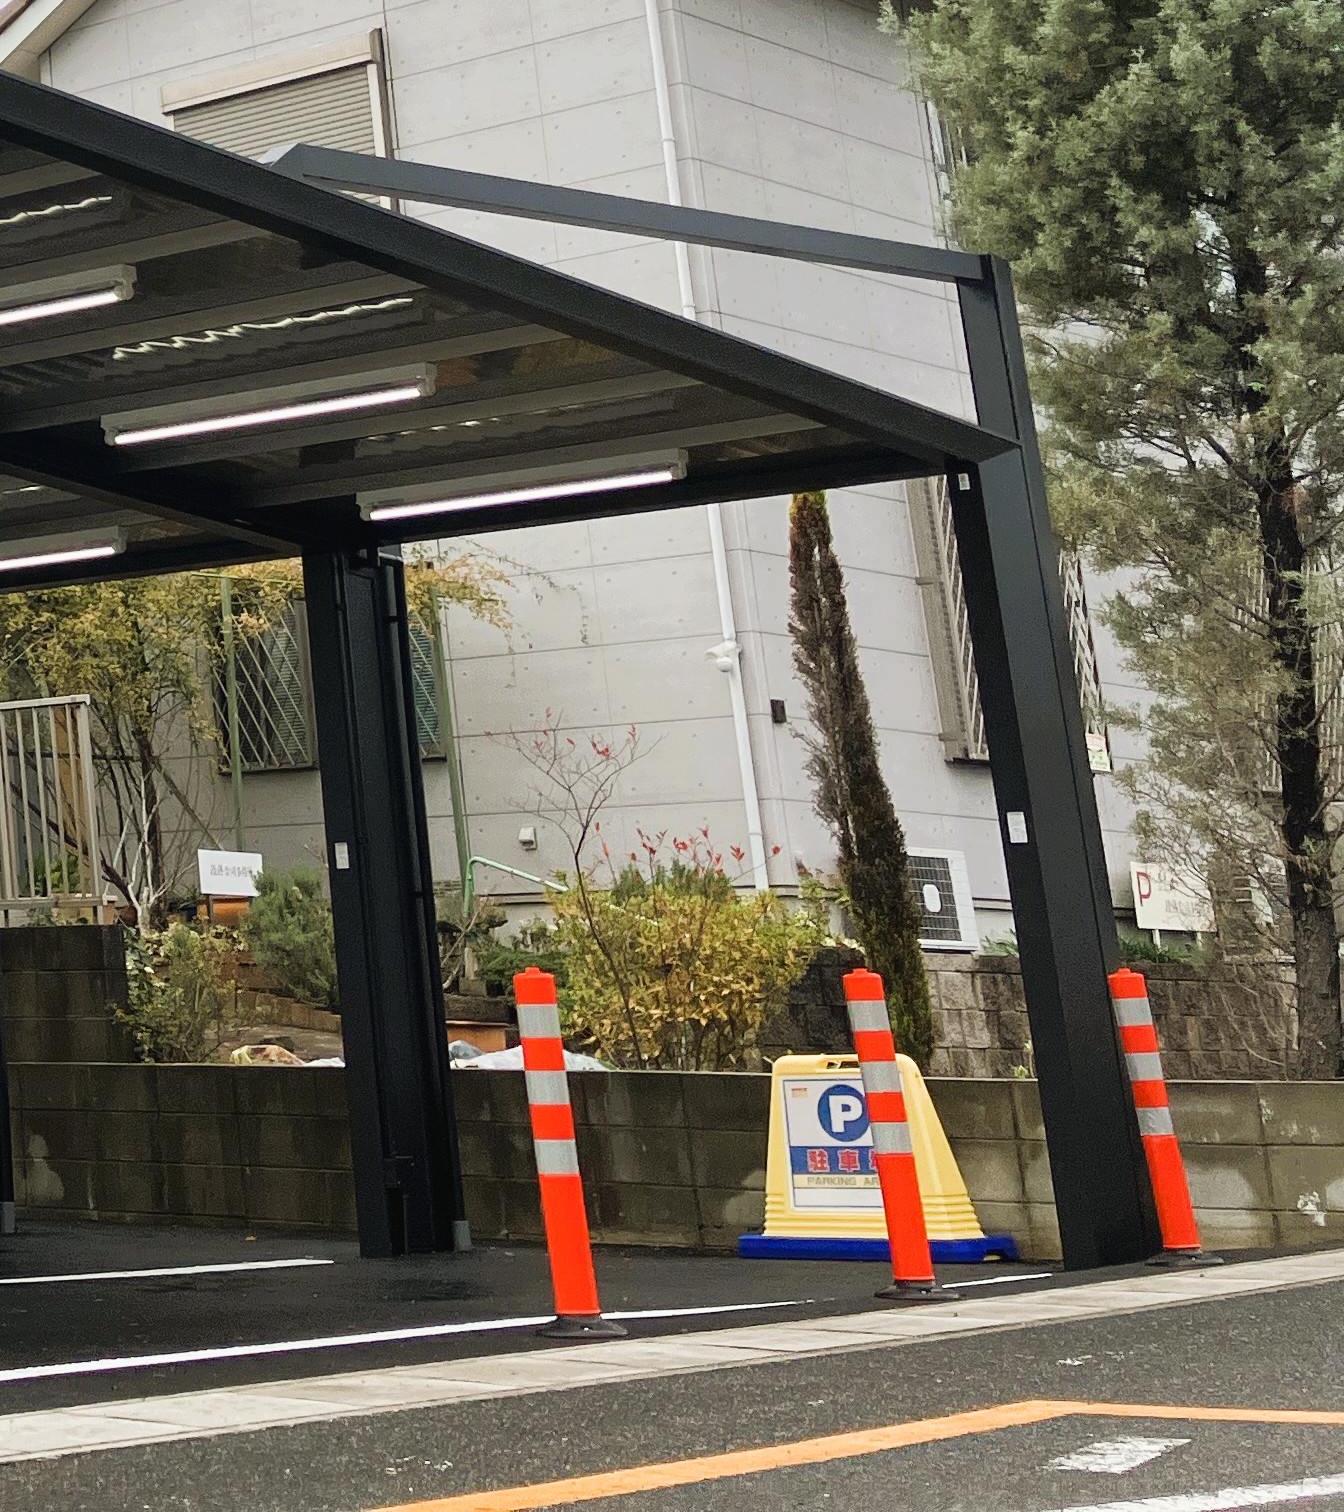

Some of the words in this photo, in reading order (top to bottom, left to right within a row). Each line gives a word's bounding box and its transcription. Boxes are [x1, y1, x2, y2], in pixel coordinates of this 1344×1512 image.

[1137, 872, 1152, 906] P
[829, 1095, 863, 1133] P
[807, 1176, 857, 1186] PARKING
